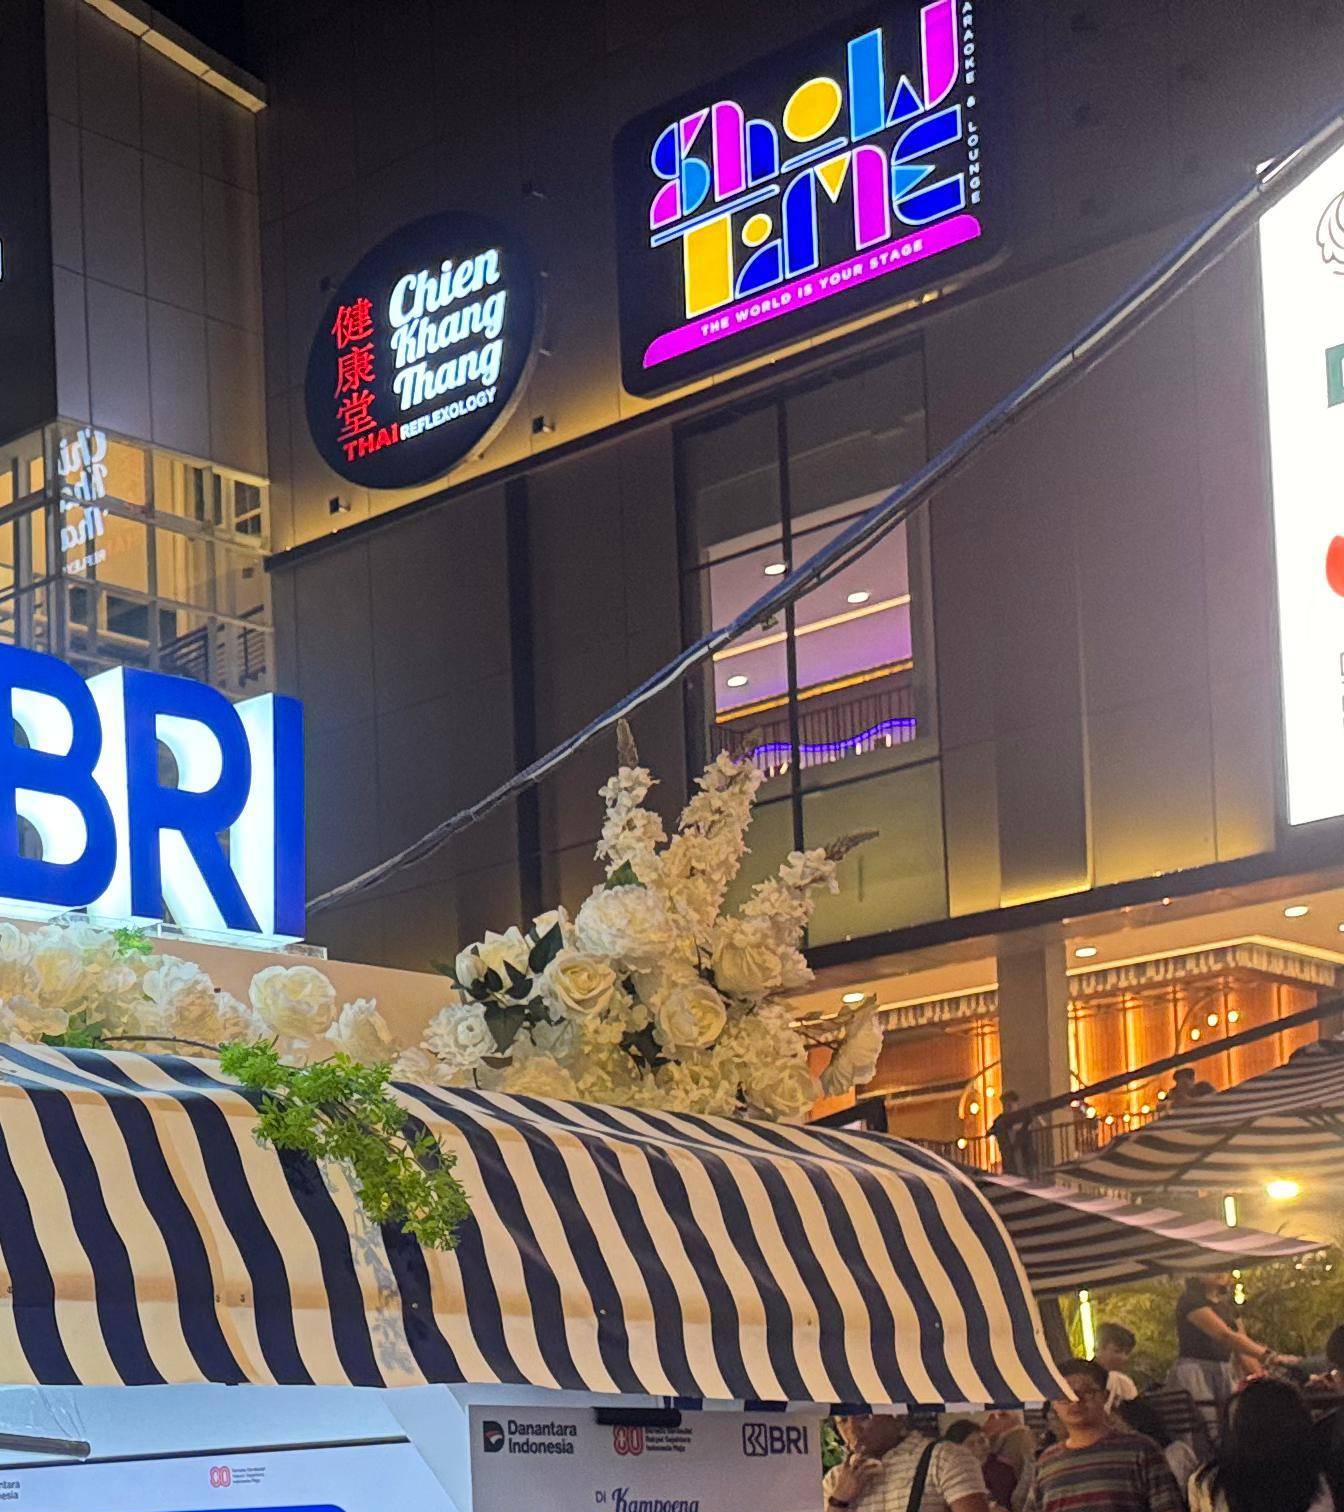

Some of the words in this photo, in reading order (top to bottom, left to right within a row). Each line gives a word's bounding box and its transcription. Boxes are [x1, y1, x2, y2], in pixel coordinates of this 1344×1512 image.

[962, 1, 975, 84] ARAOKE
[967, 121, 981, 205] LOUNGE
[388, 247, 502, 328] Chien
[700, 315, 731, 338] THE
[735, 289, 792, 326] WORLD
[797, 281, 813, 300] IS
[819, 262, 864, 295] YOUR
[869, 238, 924, 272] STAGE
[330, 295, 378, 443] 健康堂
[389, 290, 507, 370] Khang
[392, 338, 505, 411] Thang
[343, 422, 399, 462] THAI
[399, 385, 498, 441] REFLEXOLOGY
[508, 1420, 577, 1437] Danantara
[508, 1438, 574, 1455] Indonesia
[769, 1425, 808, 1455] BRI
